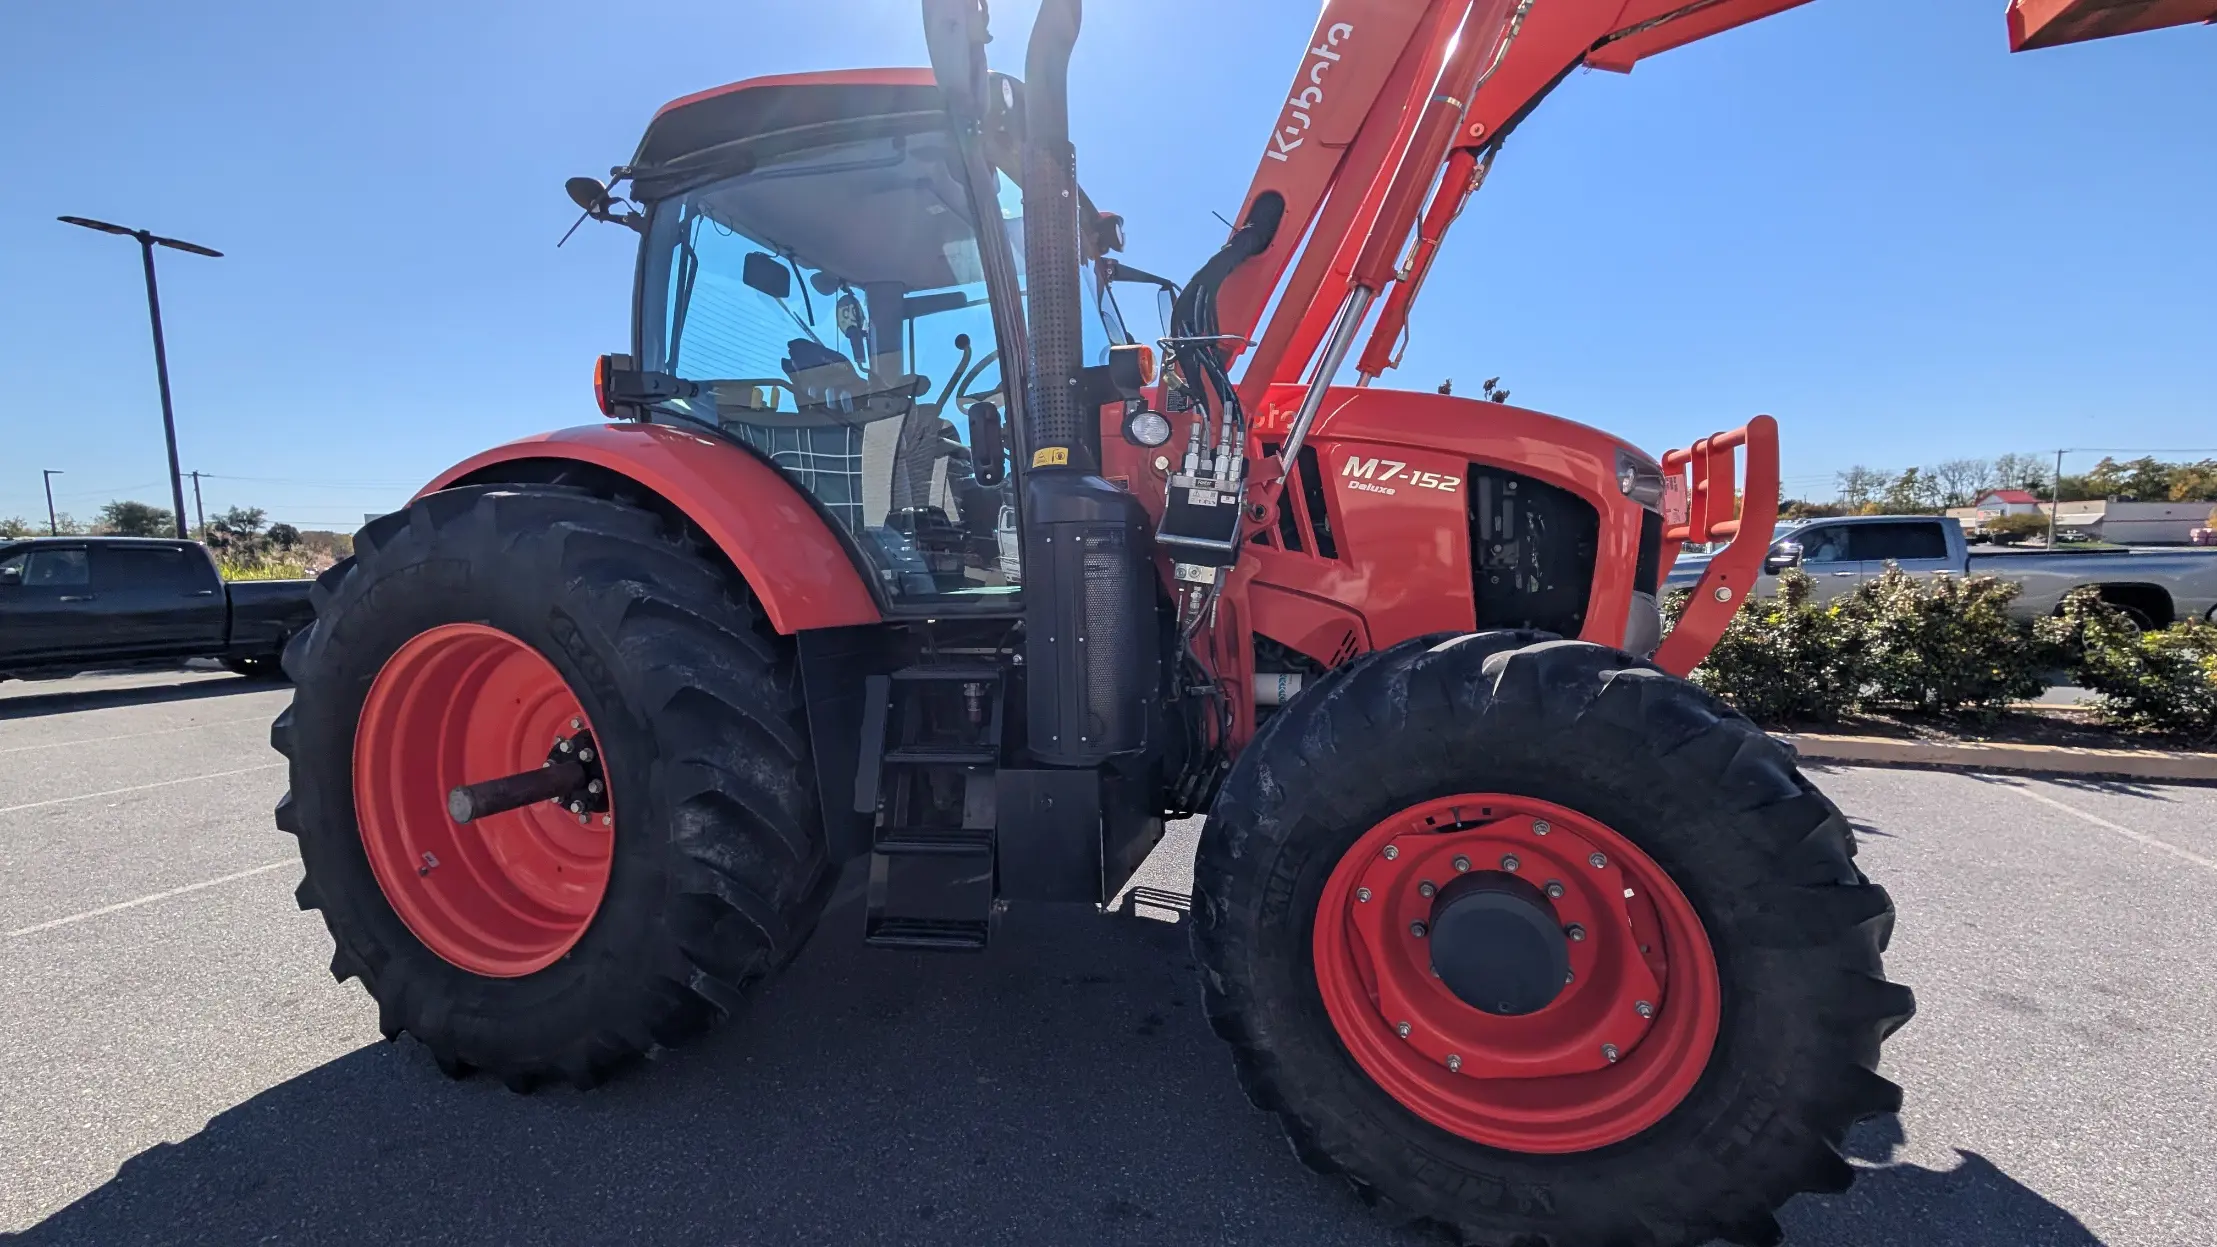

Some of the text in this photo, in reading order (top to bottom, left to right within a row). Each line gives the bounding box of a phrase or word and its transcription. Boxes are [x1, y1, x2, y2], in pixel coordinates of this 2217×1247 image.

[1266, 22, 1354, 162] Kubota
[1341, 455, 1461, 493] M7-152
[1347, 479, 1396, 496] Deluxe
